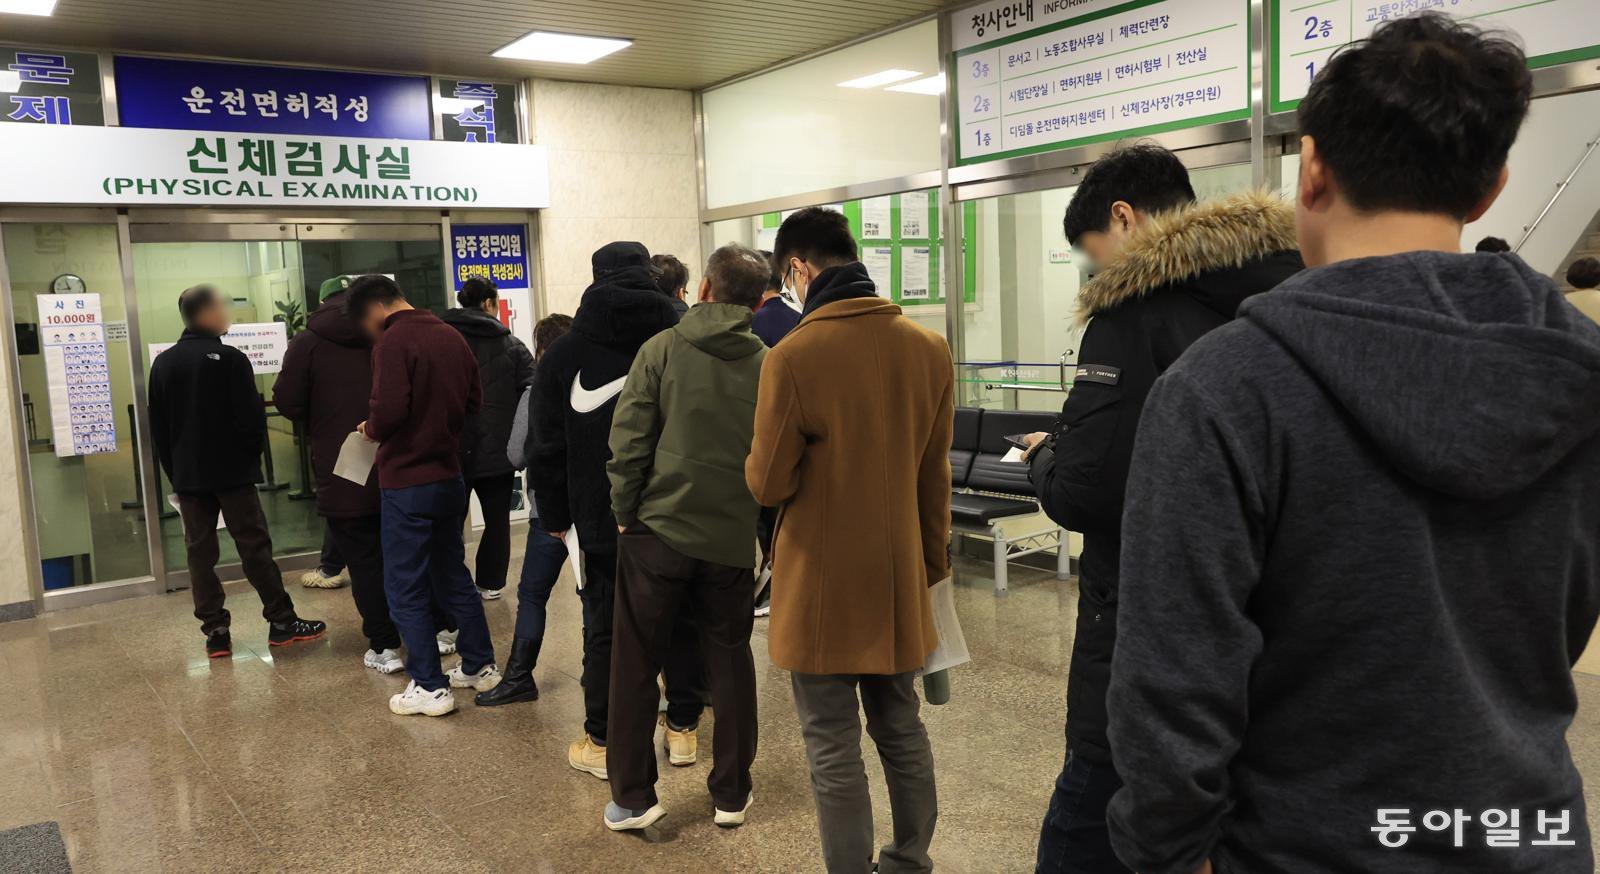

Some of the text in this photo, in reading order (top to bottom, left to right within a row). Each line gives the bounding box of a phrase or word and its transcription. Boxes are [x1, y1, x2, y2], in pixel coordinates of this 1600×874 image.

[971, 0, 1034, 37] 청사안내
[1043, 0, 1094, 15] INFORM
[1304, 15, 1333, 40] 2층
[1007, 14, 1170, 68] 문서고 노동조합사무실 체력단련장
[972, 60, 989, 79] 3층
[1008, 46, 1207, 103] 시험단장실 면허지원부 면허시험부 전산실
[182, 85, 370, 123] 운전면허적성
[973, 95, 990, 113] 2층
[1009, 85, 1221, 137] 디딤돌 운전면허지원센터 신체검사장(경무의원)
[975, 129, 992, 147] 1층
[186, 136, 412, 181] 신체검사실
[102, 176, 479, 203] (PHYSICAL EXAMINATION)
[455, 234, 522, 259] 광주 경무의원
[492, 262, 524, 281] 적성검사)
[47, 312, 96, 325] 10.000원
